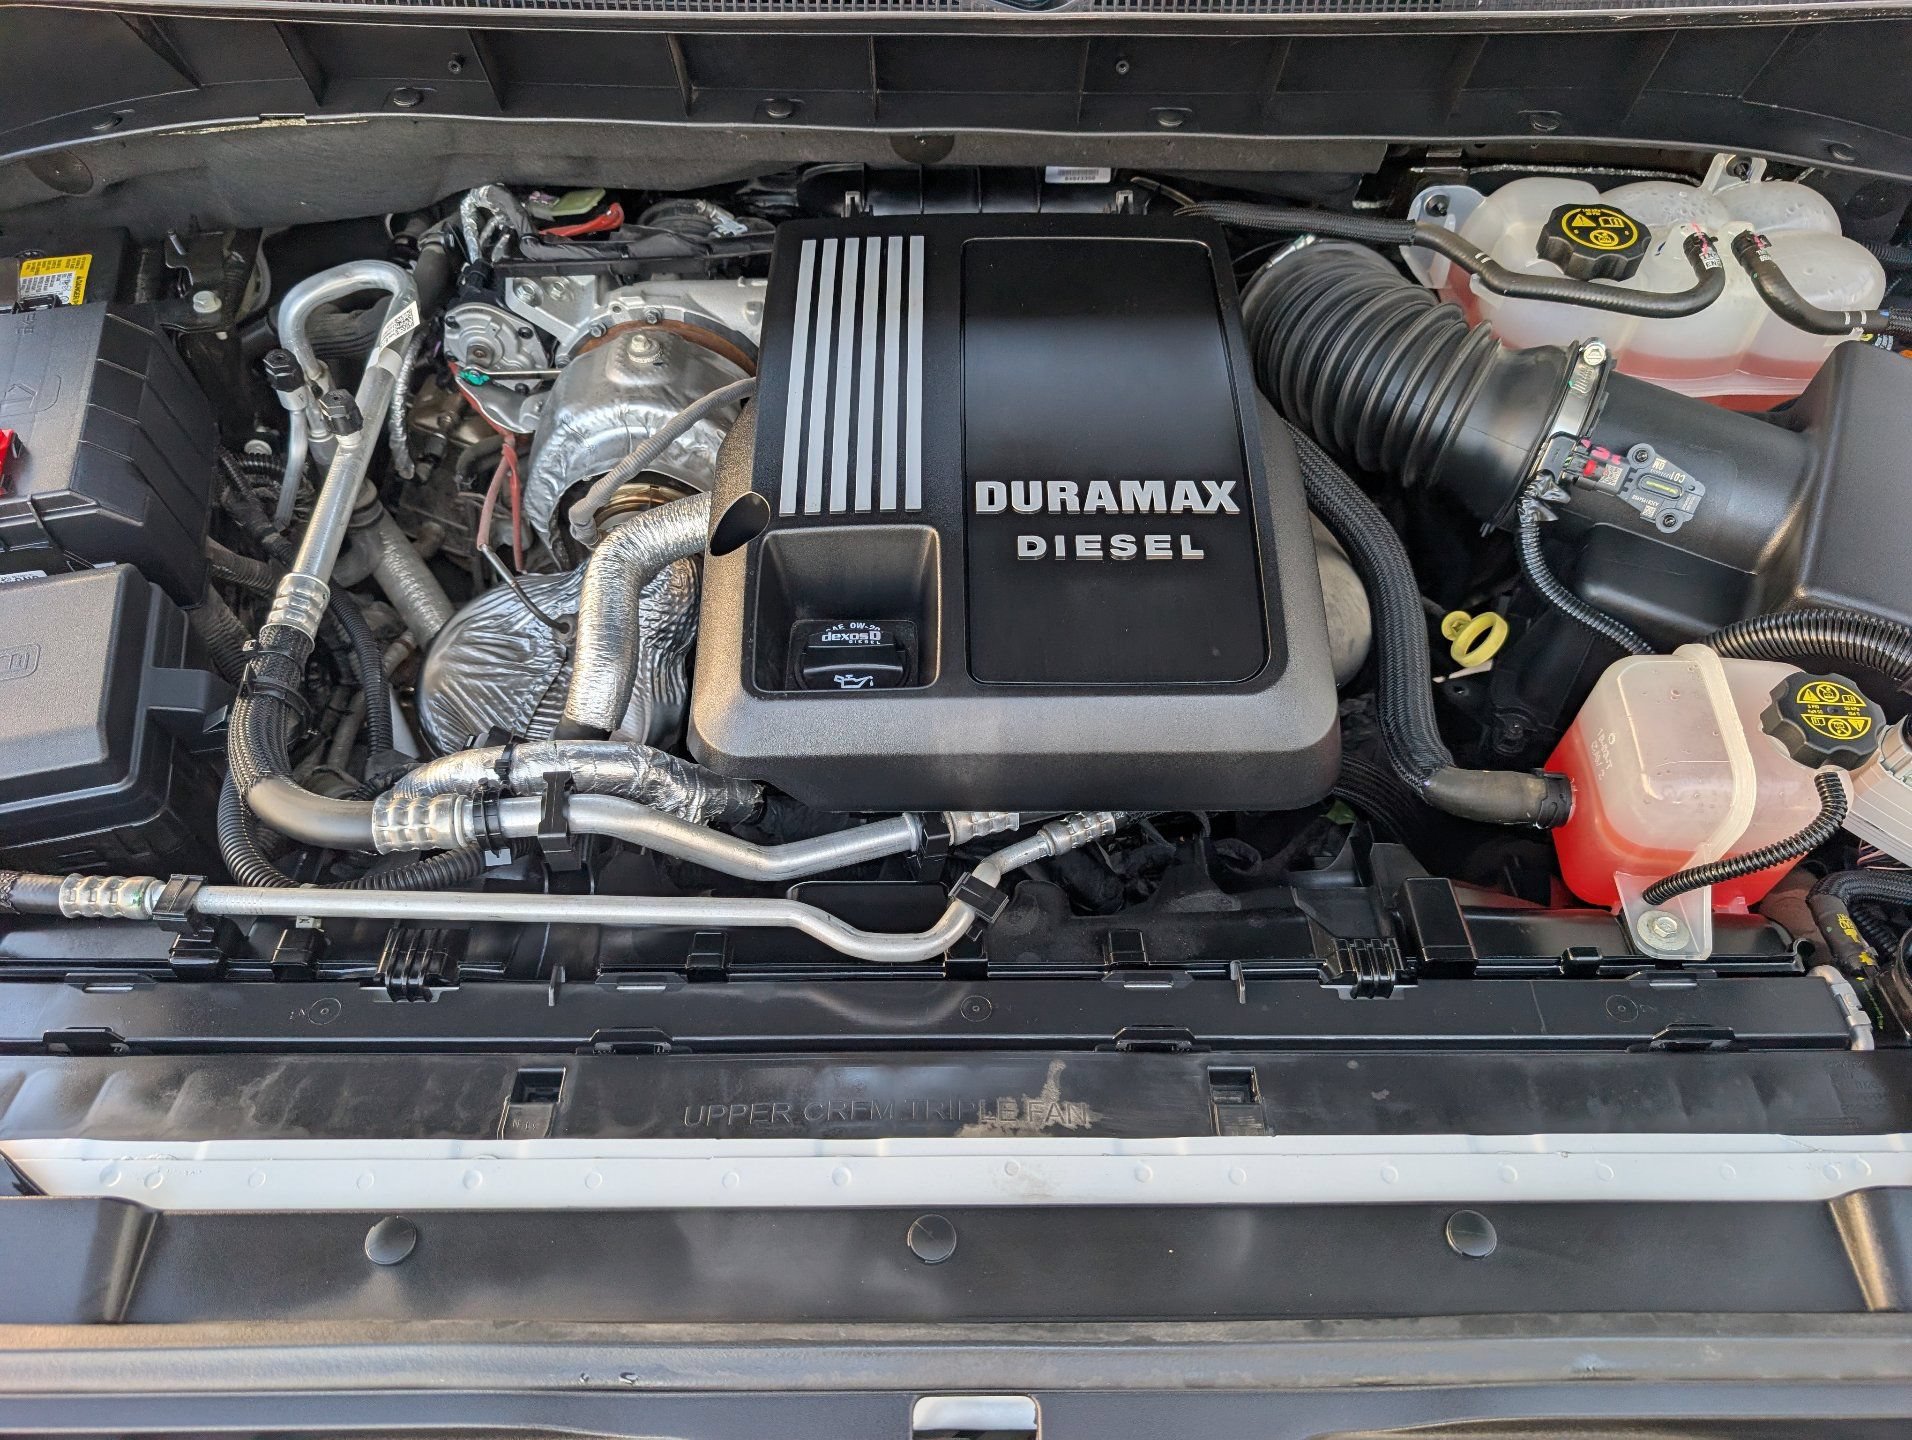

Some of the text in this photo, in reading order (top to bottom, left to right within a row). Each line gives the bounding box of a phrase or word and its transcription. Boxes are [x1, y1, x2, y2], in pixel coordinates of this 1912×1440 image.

[975, 480, 1240, 514] DURAMAX
[1017, 534, 1204, 560] DIESEL
[683, 1102, 793, 1127] UPPER
[903, 1098, 1018, 1123] TRIPLE
[1026, 1099, 1090, 1125] FAN
